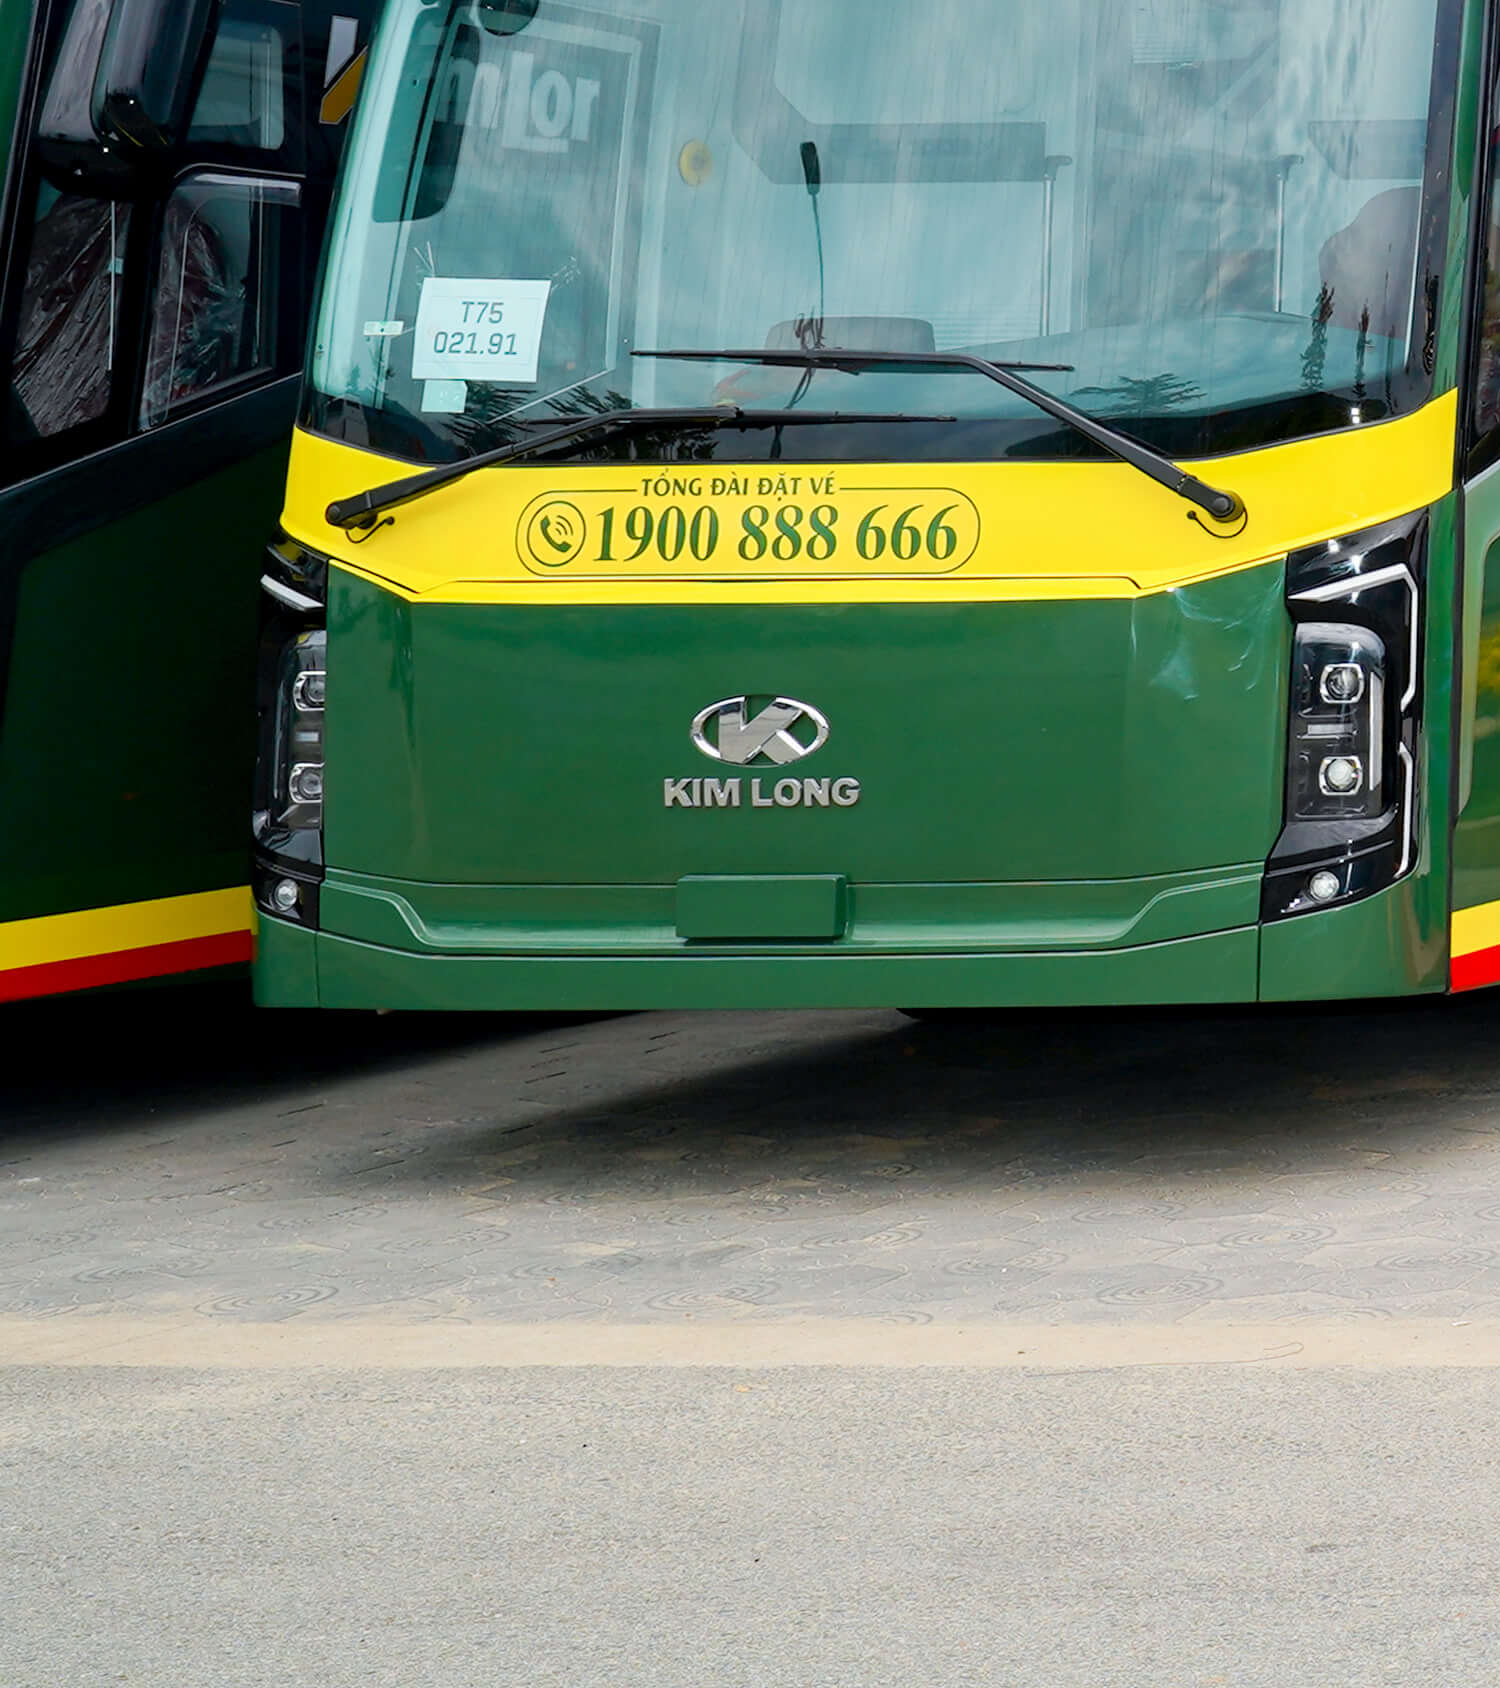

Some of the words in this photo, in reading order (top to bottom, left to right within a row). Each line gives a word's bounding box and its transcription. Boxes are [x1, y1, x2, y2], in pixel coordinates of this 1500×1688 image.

[461, 300, 504, 325] T75
[432, 330, 518, 357] 021.91
[641, 467, 703, 497] TỔNG
[710, 471, 749, 496] ĐÀI
[757, 472, 801, 501] ĐẶT
[809, 470, 836, 496] VÉ
[594, 503, 719, 562] 1900
[737, 503, 839, 562] 888
[855, 503, 958, 562] 666
[664, 778, 741, 808] KIM
[751, 778, 861, 808] LONG
